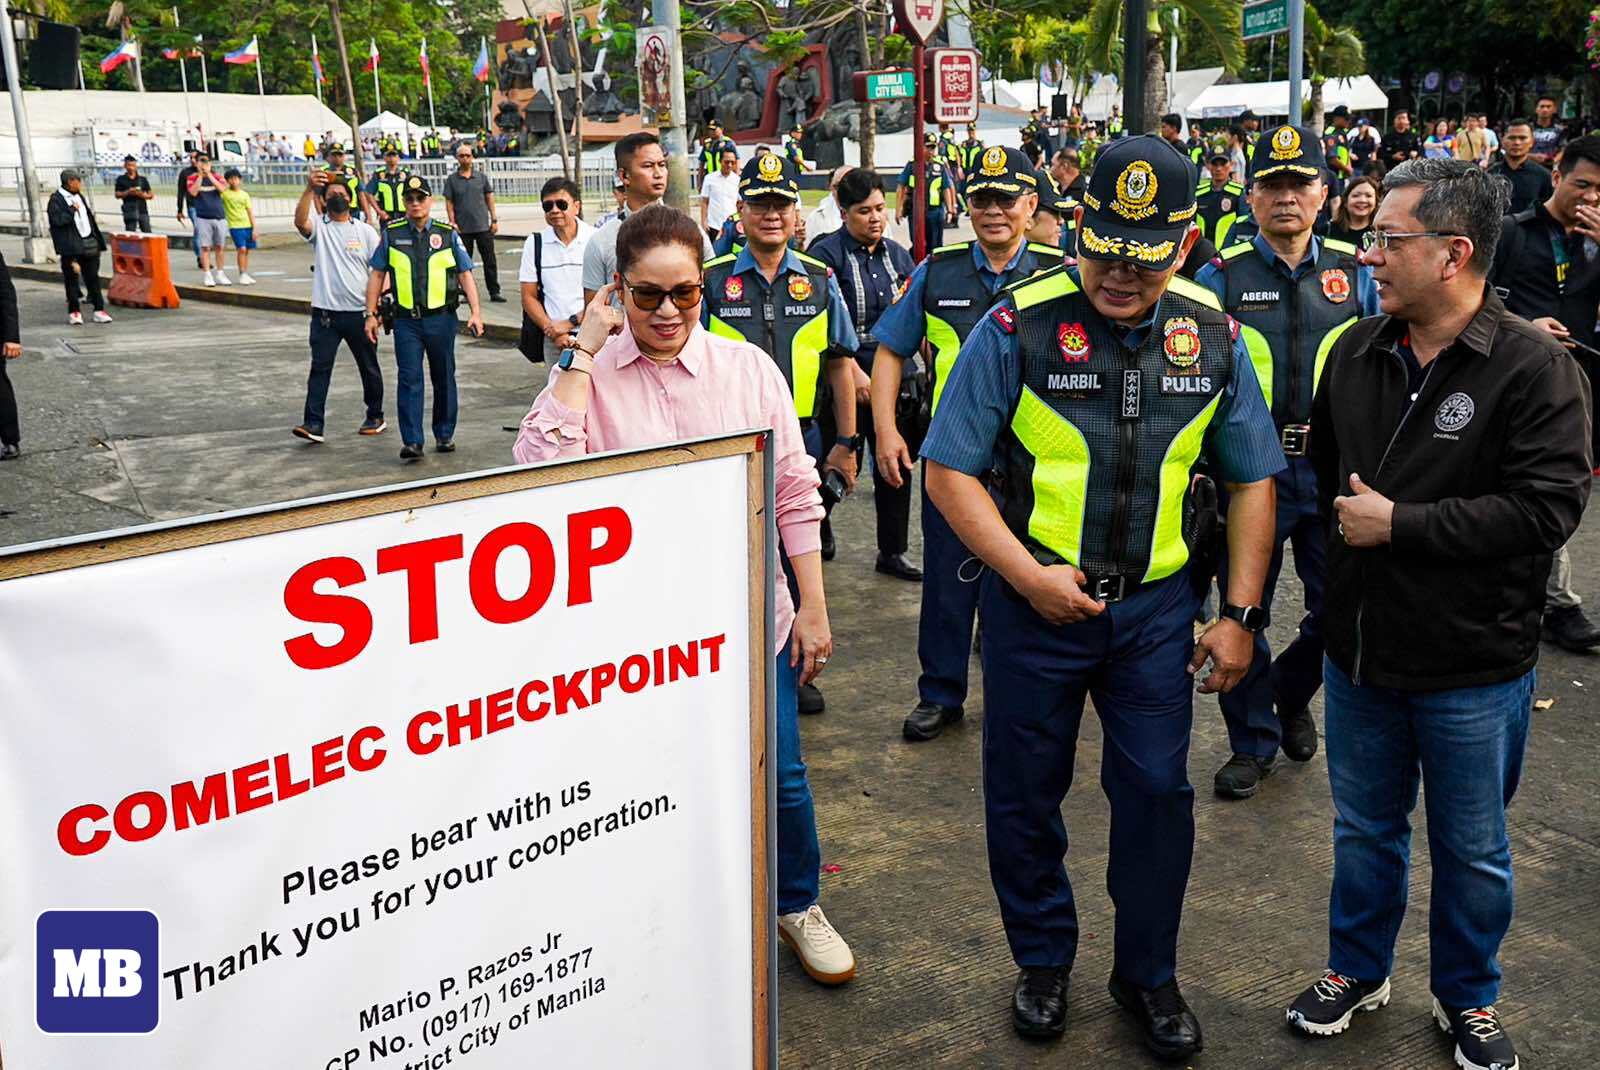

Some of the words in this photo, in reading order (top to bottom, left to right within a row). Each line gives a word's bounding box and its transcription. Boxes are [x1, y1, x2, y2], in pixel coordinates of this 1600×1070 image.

[877, 73, 903, 85] MANILA
[875, 86, 889, 97] CITY
[891, 85, 907, 97] HALL
[942, 107, 954, 116] BUS
[1241, 291, 1279, 301] ABERIN
[720, 307, 752, 317] SALVADOR
[785, 306, 816, 315] PULIS
[1048, 374, 1101, 389] MARBIL
[1162, 376, 1211, 392] PULIS
[283, 506, 633, 670] STOP
[57, 725, 387, 857] COMELEC
[407, 634, 726, 756] CHECKPOINT
[283, 848, 400, 905] Please
[411, 815, 478, 861] bear
[487, 792, 552, 833] with
[561, 781, 592, 808] us
[162, 931, 282, 1001] Thank
[292, 907, 360, 958] you
[372, 883, 416, 921] for
[424, 855, 498, 906] your
[508, 792, 677, 871] cooperation.
[359, 989, 431, 1033] Mario
[440, 977, 460, 1001] P.
[468, 945, 533, 989] Razos
[540, 931, 562, 955] Jr
[369, 1035, 414, 1062] No.
[422, 992, 491, 1046] (0917)
[498, 947, 593, 1004] 169-1877
[458, 1021, 501, 1055] City
[508, 1003, 531, 1031] of
[537, 975, 606, 1019] Manila
